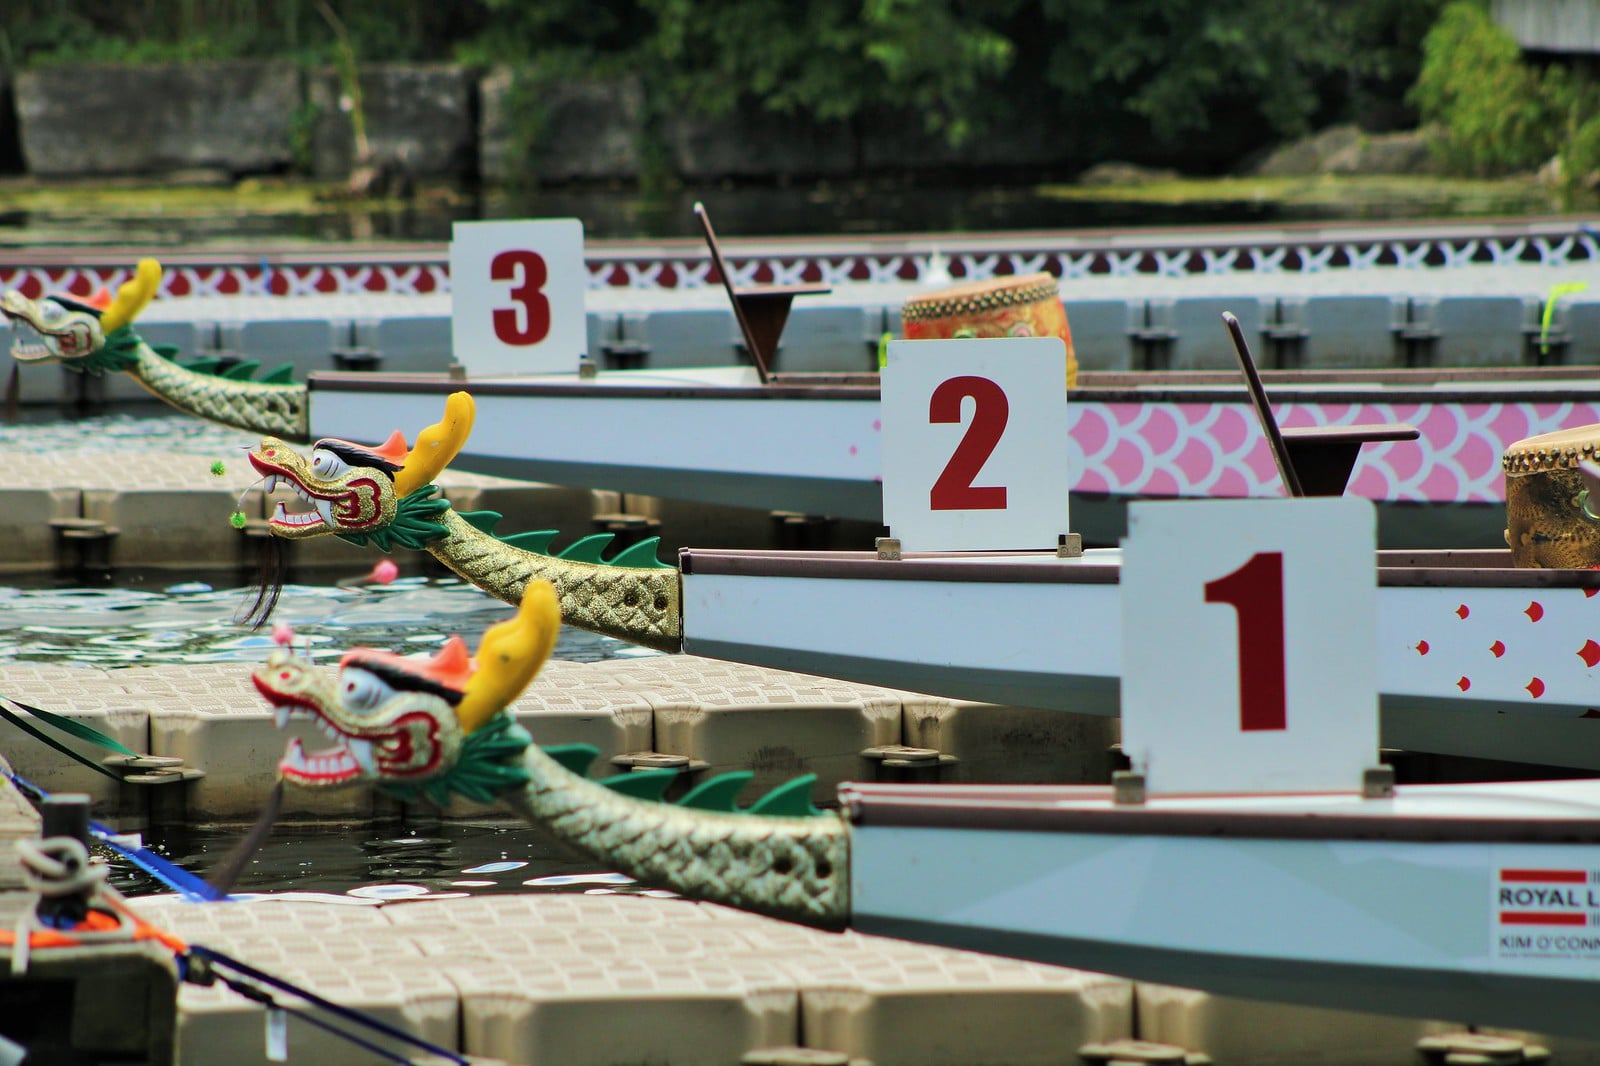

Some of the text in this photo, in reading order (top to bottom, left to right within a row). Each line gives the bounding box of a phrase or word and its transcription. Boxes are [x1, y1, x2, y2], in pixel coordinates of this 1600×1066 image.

[491, 250, 550, 346] 3
[929, 376, 1009, 511] 2
[1204, 551, 1287, 732] 1
[1499, 887, 1580, 907] ROYAL
[1500, 936, 1532, 949] KIM
